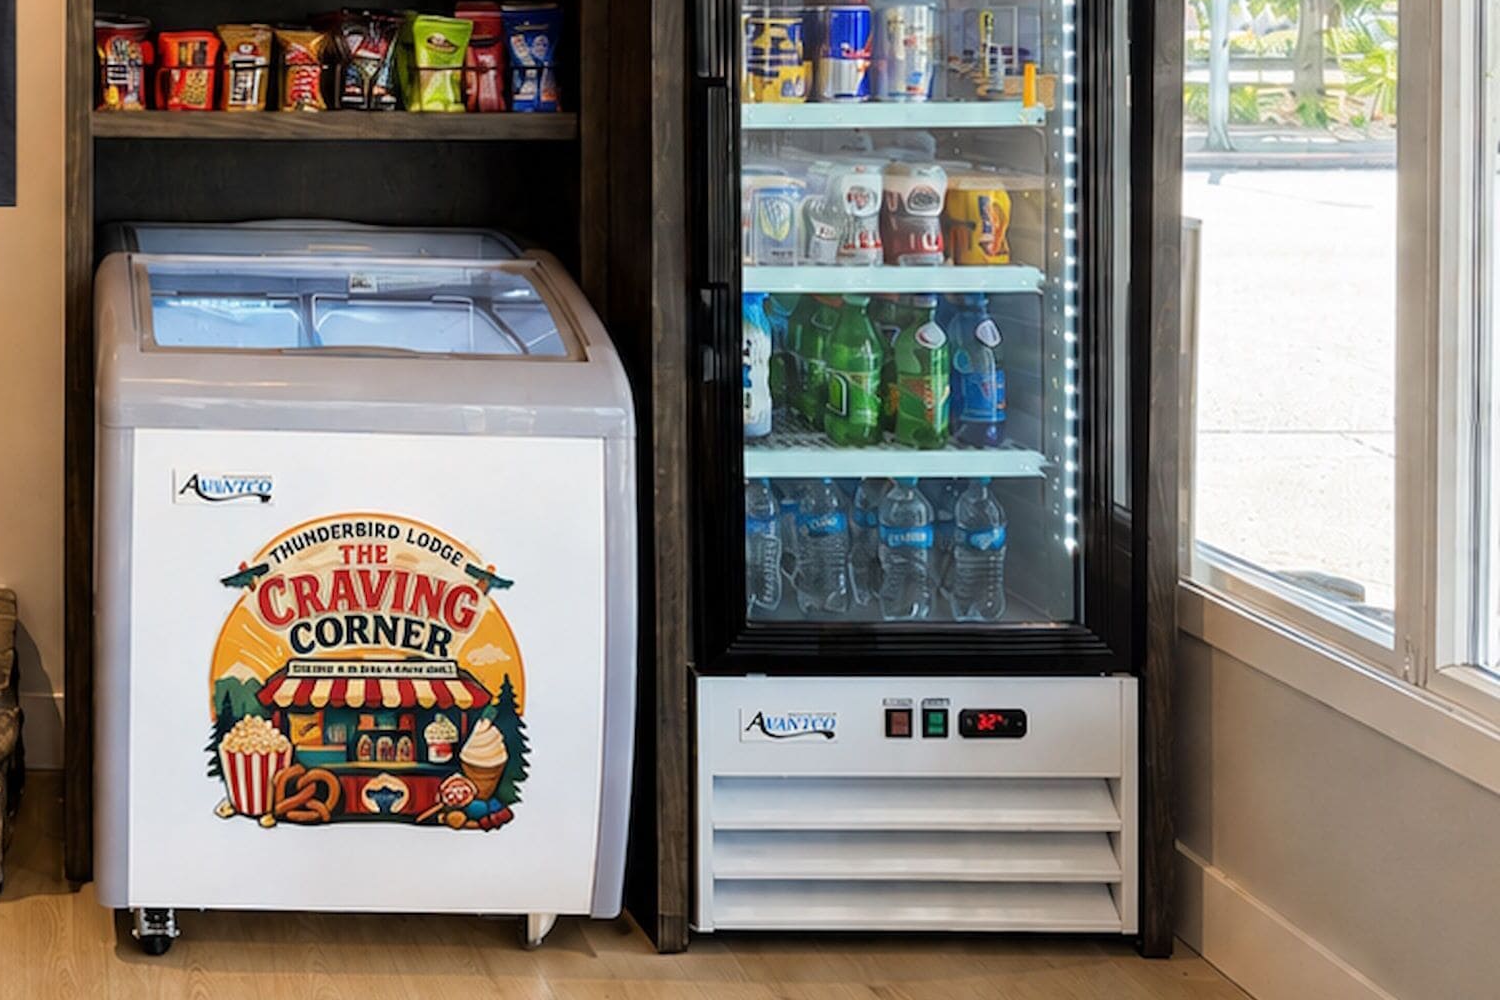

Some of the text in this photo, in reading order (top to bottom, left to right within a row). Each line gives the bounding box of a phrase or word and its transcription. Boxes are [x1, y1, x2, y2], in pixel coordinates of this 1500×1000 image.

[269, 522, 464, 567] THUNDERBIRD LODGE
[338, 544, 389, 565] THE
[257, 569, 480, 631] CRAVING
[289, 614, 453, 658] CORNER
